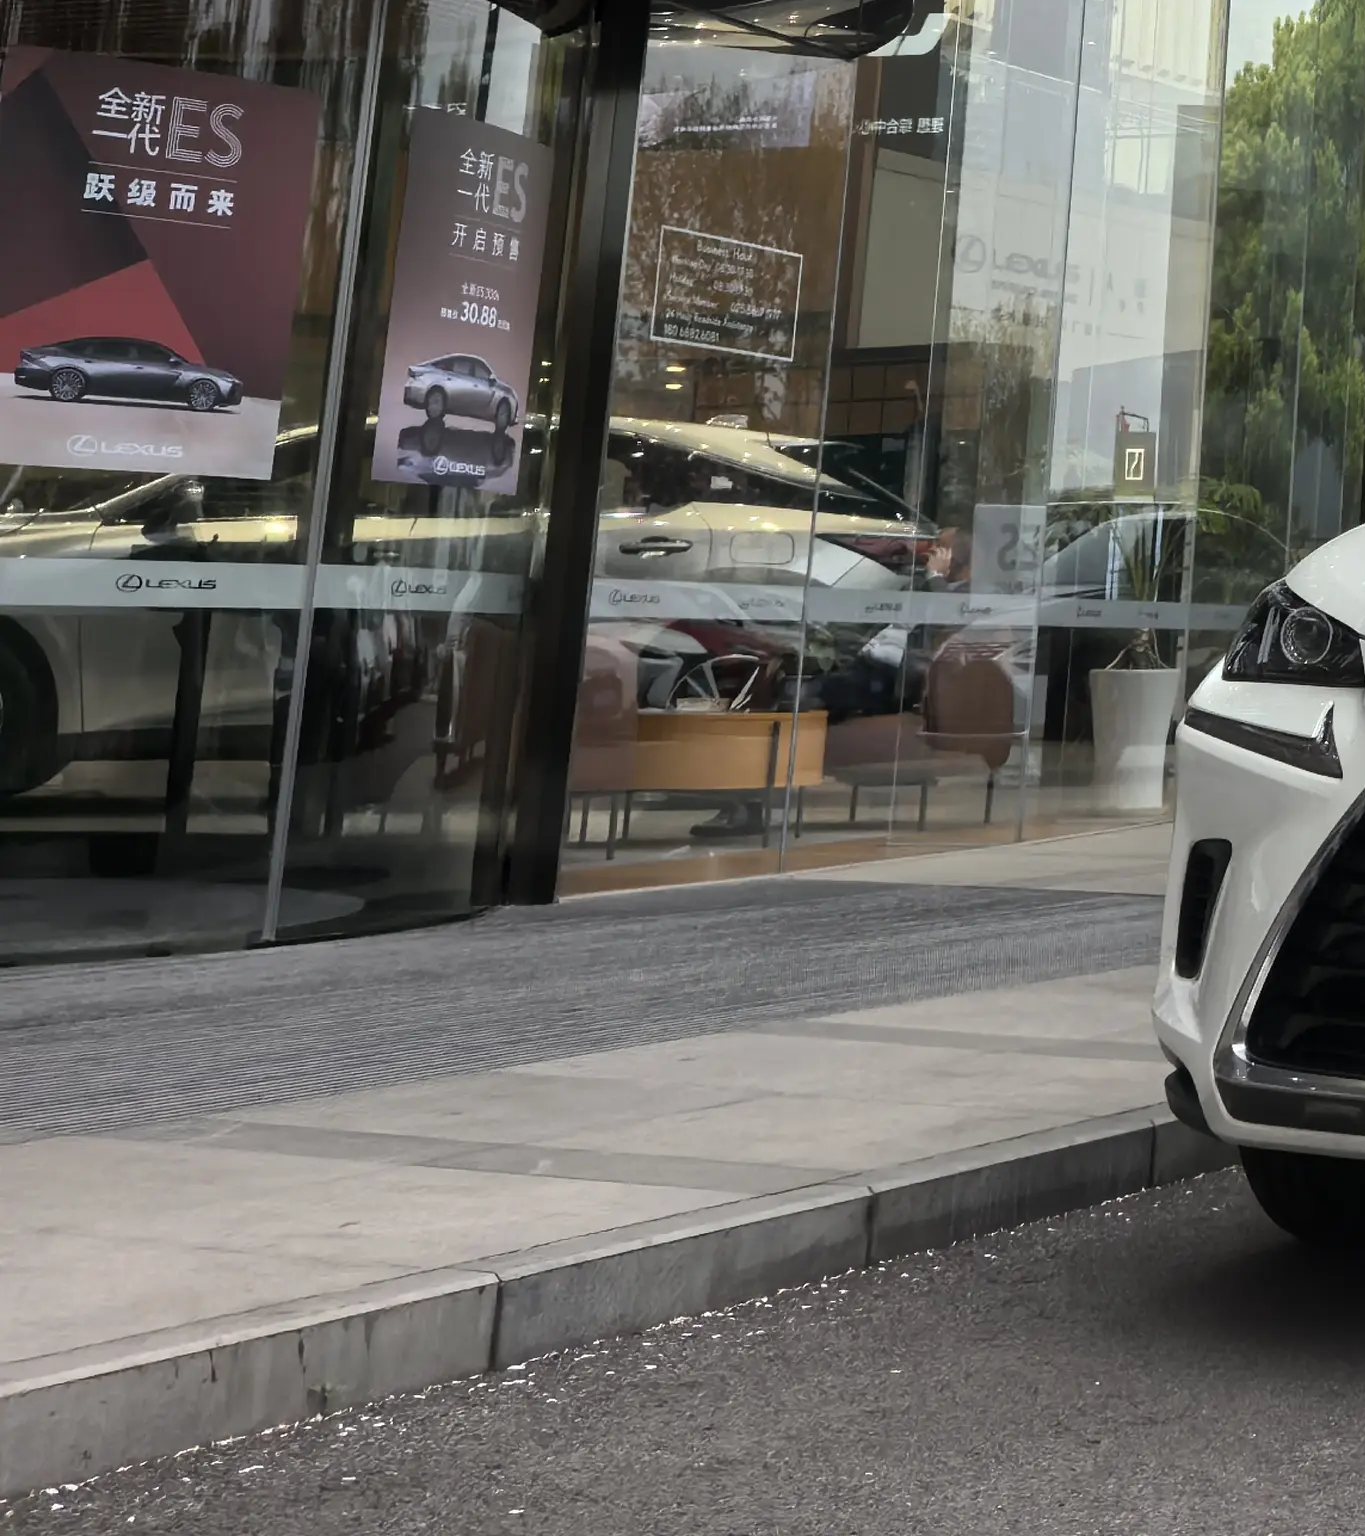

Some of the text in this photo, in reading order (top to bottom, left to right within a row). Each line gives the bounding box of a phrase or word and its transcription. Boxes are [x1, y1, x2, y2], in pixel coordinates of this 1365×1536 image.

[92, 123, 160, 155] 一代
[96, 87, 244, 168] 全新 ES
[83, 172, 234, 216] 跃级而来
[456, 182, 490, 213] 一代
[458, 148, 529, 223] 全新 ES
[451, 222, 520, 261] 开启预售
[460, 301, 497, 328] 30.88
[101, 442, 183, 458] LEXUS
[450, 462, 485, 476] LEXUS
[146, 579, 217, 590] LEXUS
[408, 584, 448, 595] LEXUS
